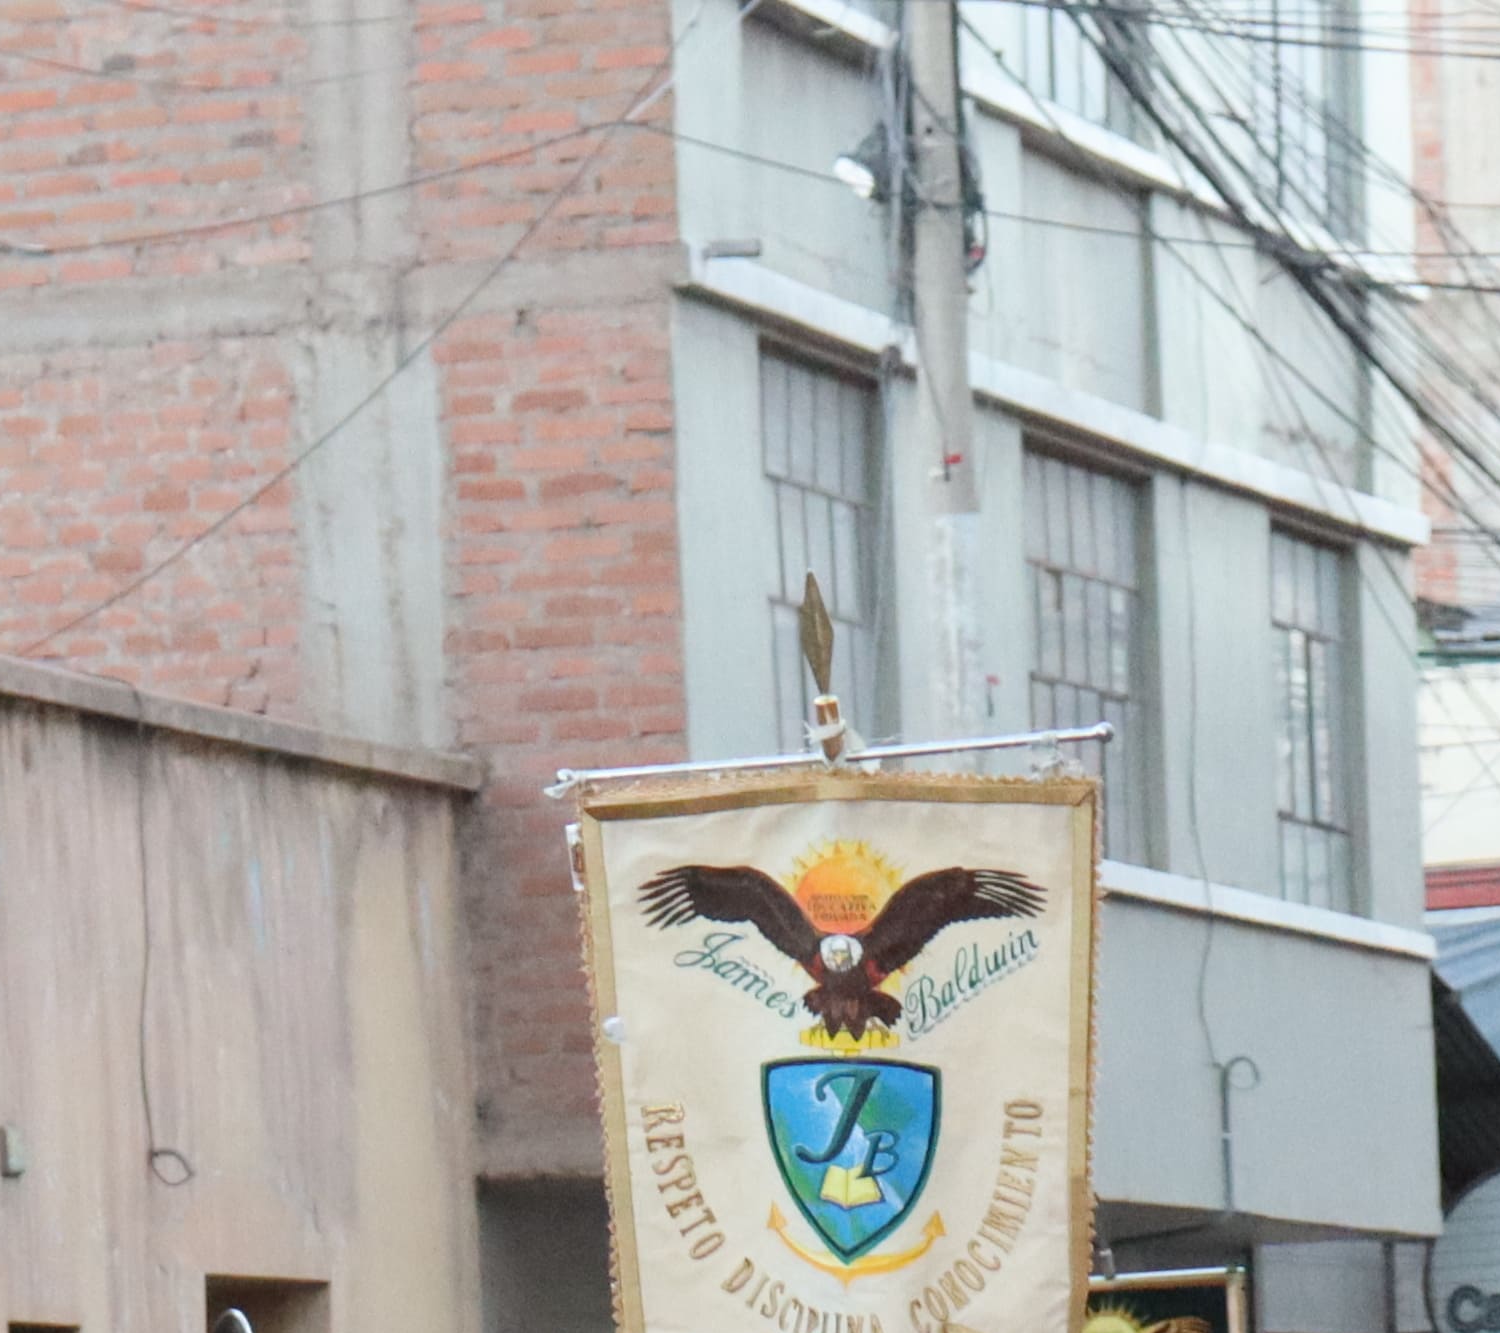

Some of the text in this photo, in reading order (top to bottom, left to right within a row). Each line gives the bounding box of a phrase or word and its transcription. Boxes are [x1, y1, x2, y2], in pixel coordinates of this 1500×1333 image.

[672, 928, 1040, 1040] James Baldwin
[641, 1101, 725, 1260] RESPETO
